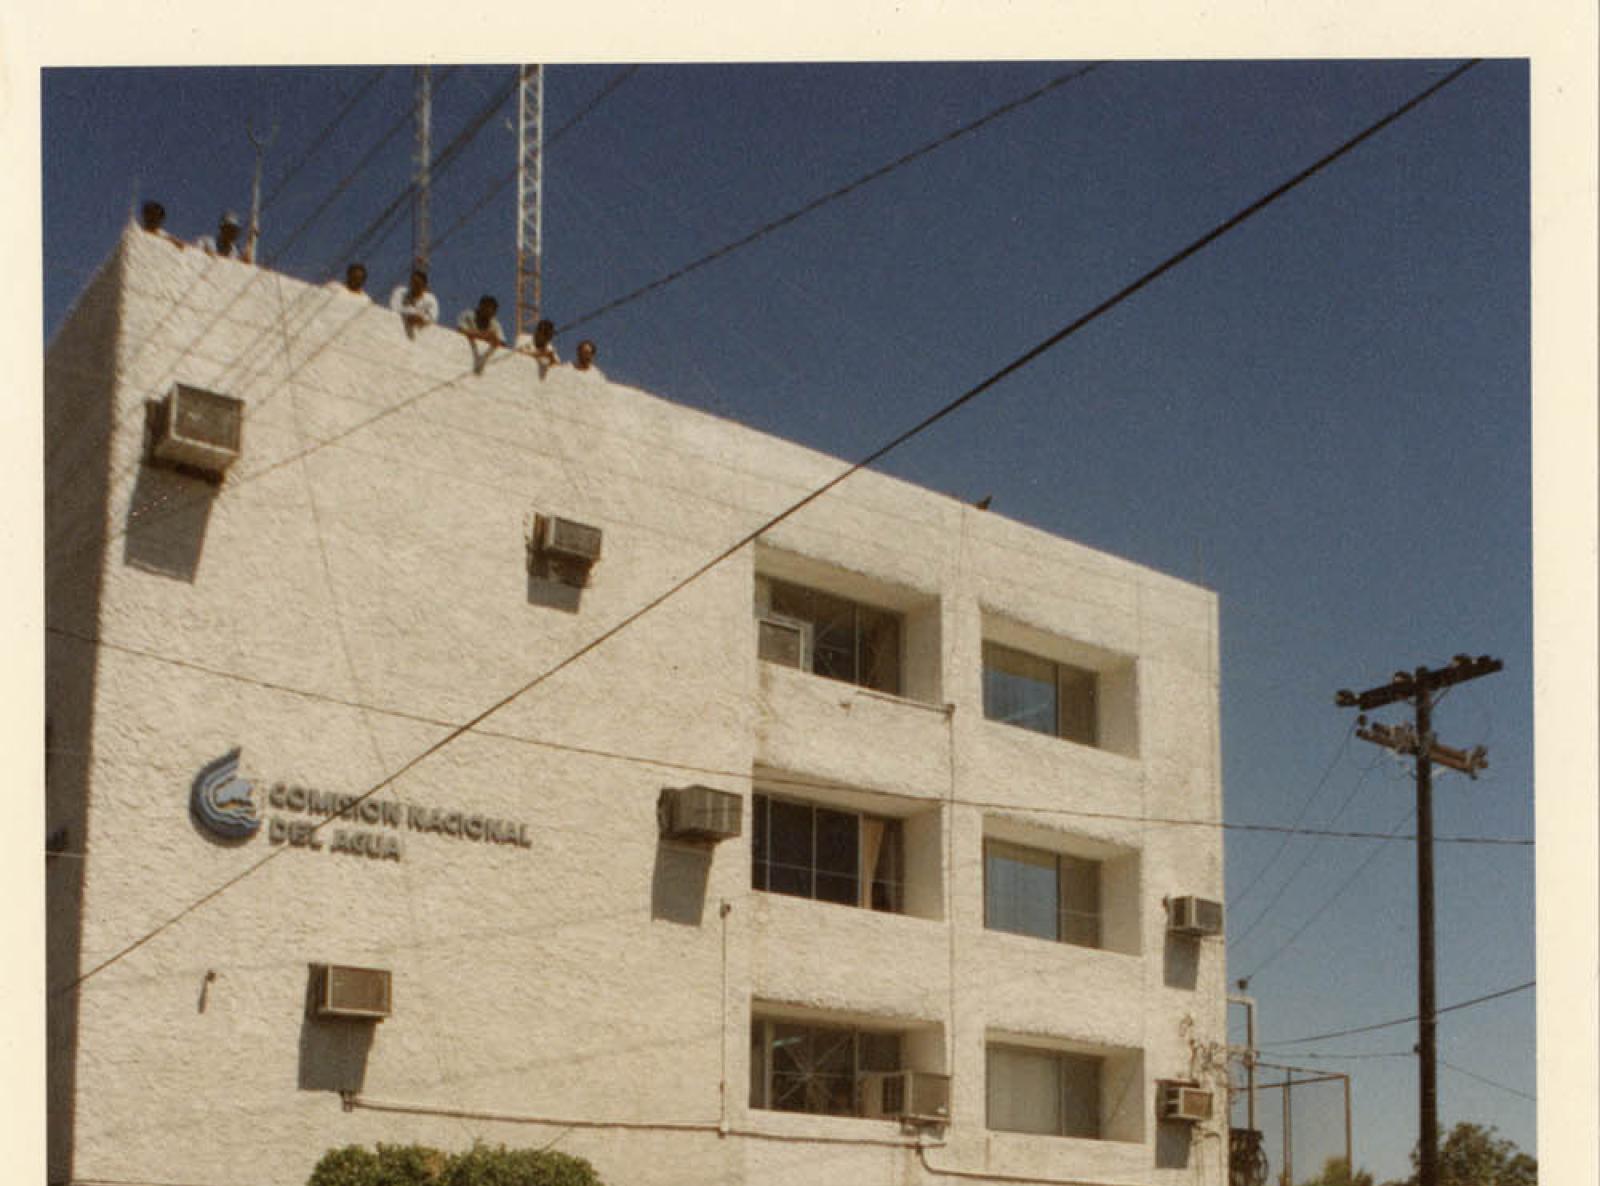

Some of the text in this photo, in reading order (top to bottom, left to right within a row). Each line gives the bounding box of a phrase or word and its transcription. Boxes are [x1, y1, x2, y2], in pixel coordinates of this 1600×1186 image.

[269, 782, 532, 848] COMISION NACIONAL
[269, 819, 399, 861] DEL AGUA
